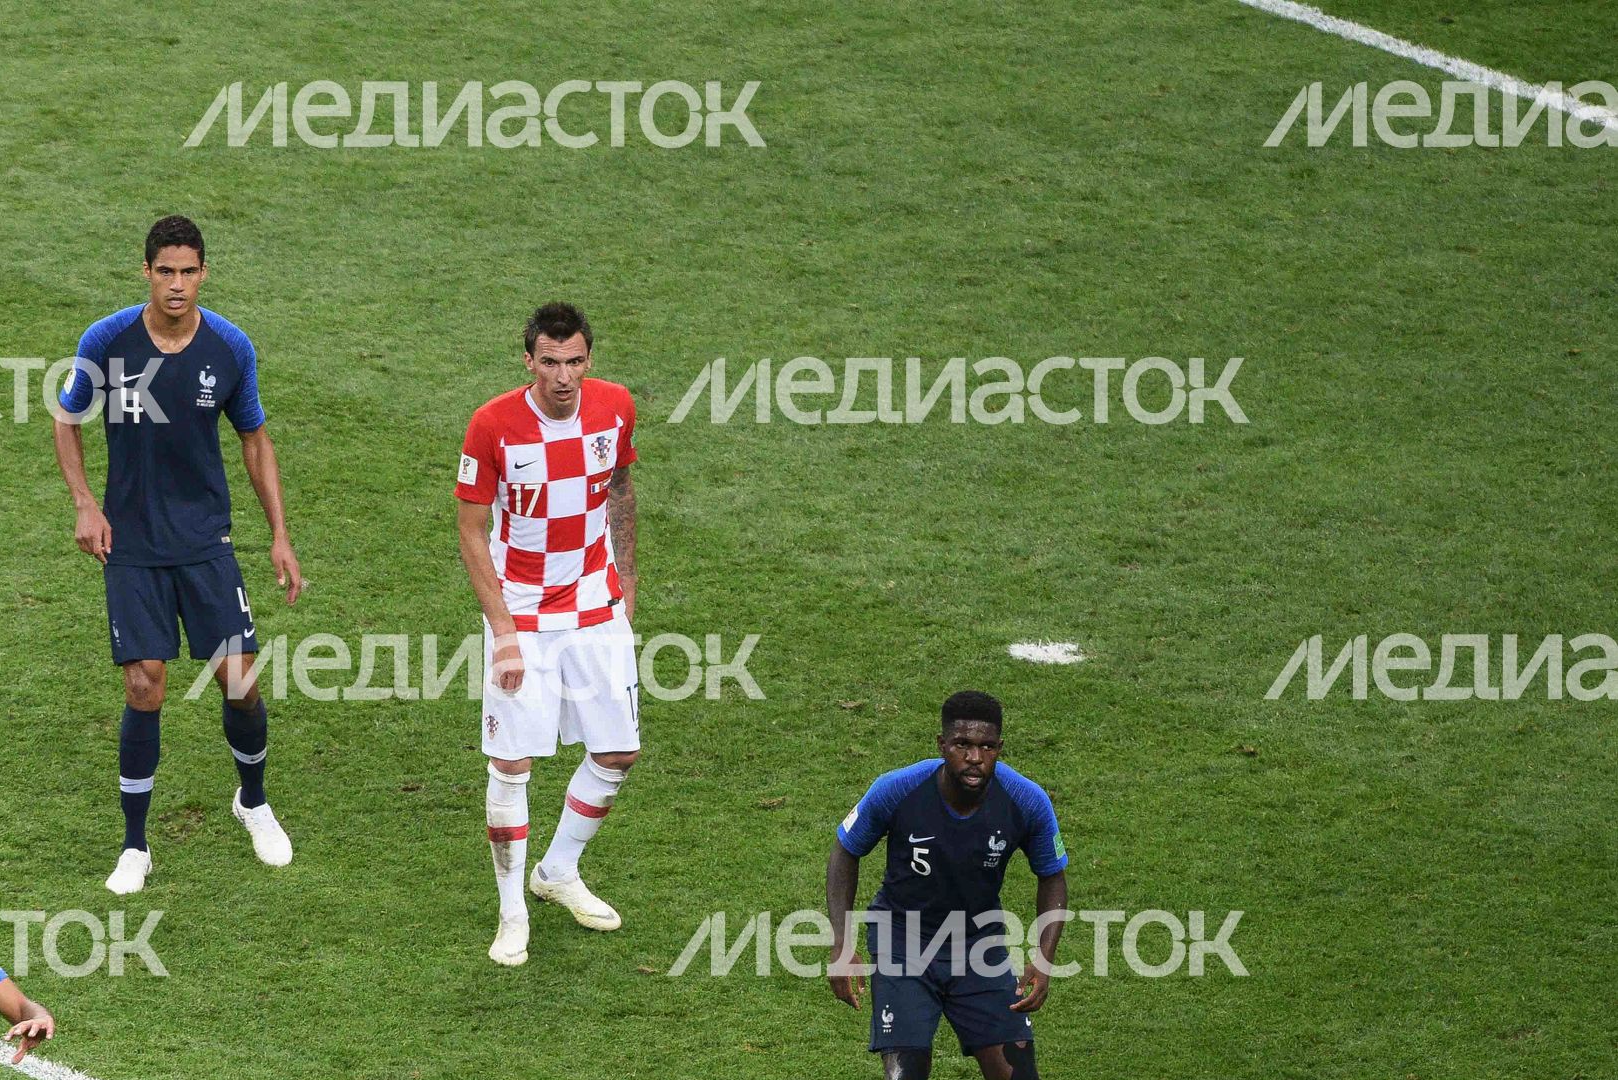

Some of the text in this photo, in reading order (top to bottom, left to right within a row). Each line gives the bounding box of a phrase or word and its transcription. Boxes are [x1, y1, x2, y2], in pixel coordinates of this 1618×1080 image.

[120, 387, 144, 424] 4
[511, 483, 543, 517] 17
[236, 586, 253, 623] 4
[910, 847, 932, 877] 5
